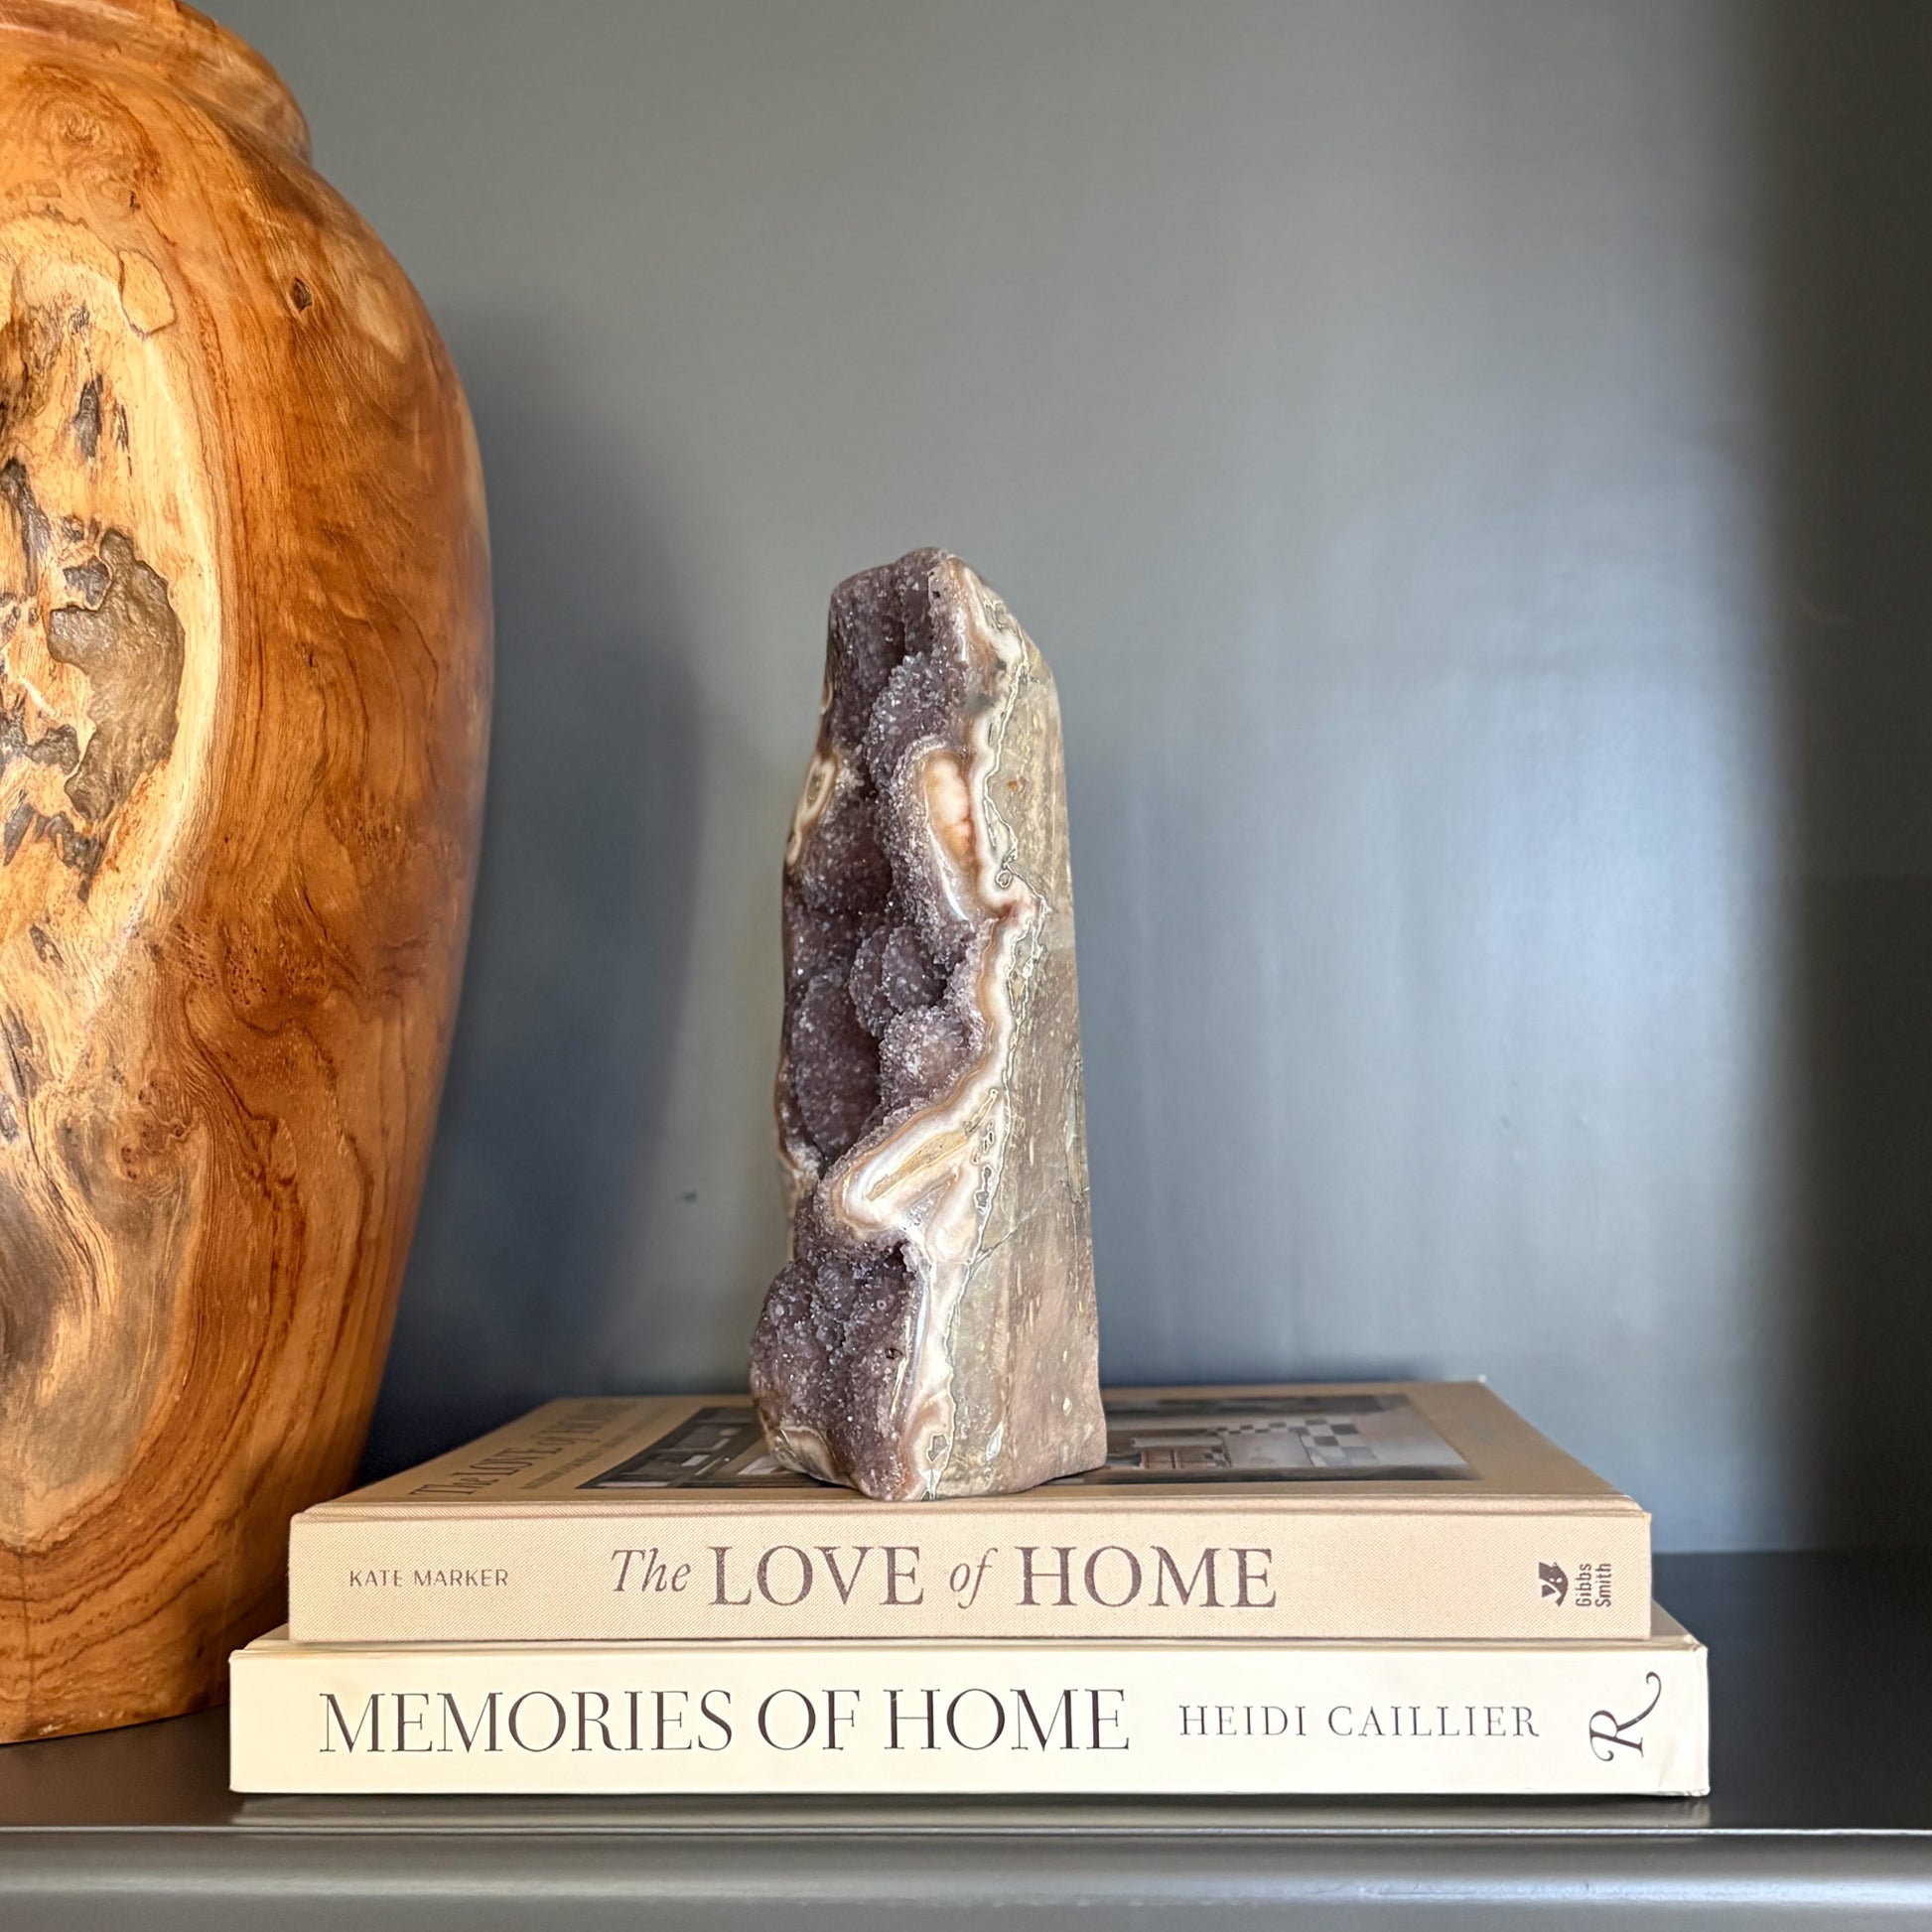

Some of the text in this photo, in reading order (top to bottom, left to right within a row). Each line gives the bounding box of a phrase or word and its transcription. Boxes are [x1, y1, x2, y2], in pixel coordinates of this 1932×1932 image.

[451, 1447, 563, 1476] LOVE
[408, 1476, 498, 1495] The
[349, 1569, 509, 1587] KATE MARKER
[611, 1544, 1277, 1610] The LOVE of HOME
[1575, 1563, 1592, 1607] Gibbs
[1593, 1562, 1612, 1607] Smith
[319, 1687, 1130, 1754] MEMORIES OF HOME
[1178, 1704, 1540, 1738] HEIDI CAILLIER
